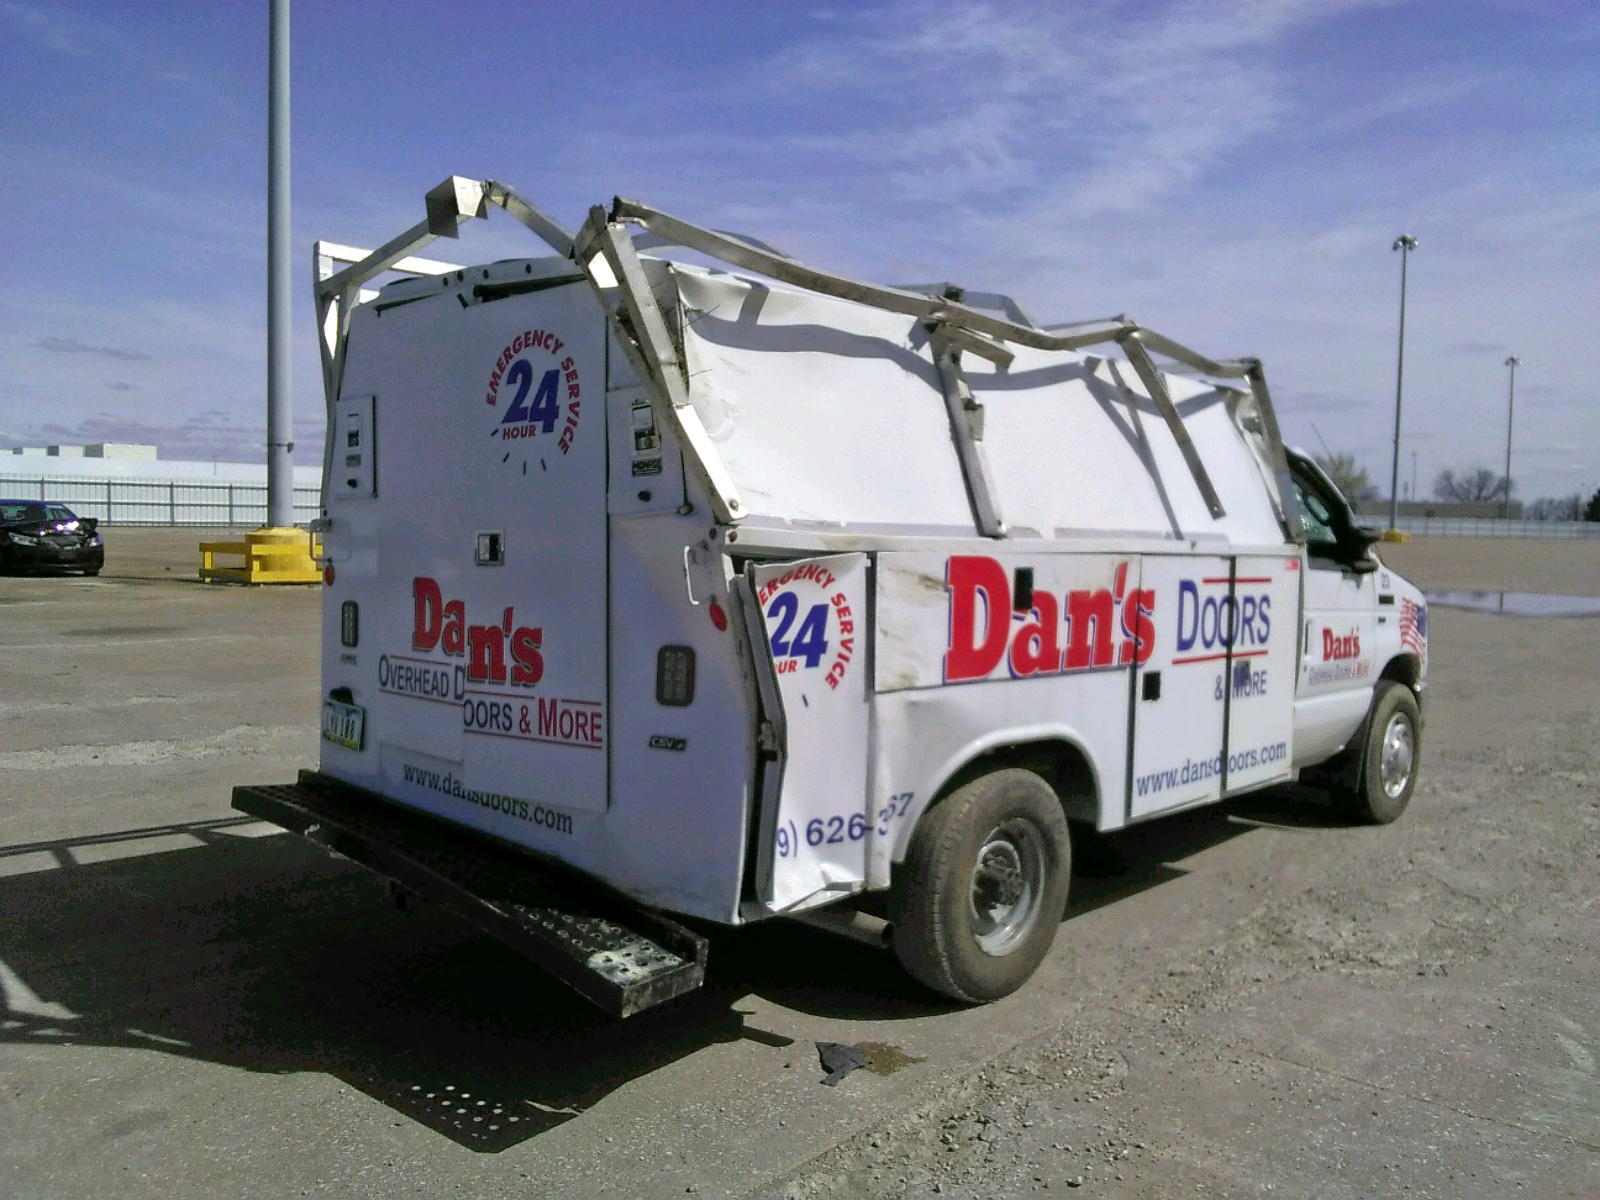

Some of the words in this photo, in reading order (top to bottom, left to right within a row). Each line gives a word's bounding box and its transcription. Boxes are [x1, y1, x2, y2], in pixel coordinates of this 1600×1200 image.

[486, 329, 564, 406] EMERGENCY
[557, 356, 581, 455] SERVICE
[501, 358, 561, 433] 24
[502, 424, 536, 440] HOUR
[412, 576, 544, 688] Dan's
[767, 591, 829, 669] 24
[825, 592, 854, 690] SERVICE
[943, 555, 1156, 685] Dan's
[1177, 579, 1272, 651] DOORS
[1322, 626, 1360, 661] Dan's
[379, 654, 449, 698] OVERHEAD
[454, 664, 513, 732] DOORS
[519, 704, 532, 734] &
[538, 697, 603, 742] MORE
[775, 659, 798, 674] UR
[1214, 674, 1223, 701] &
[1136, 742, 1287, 796] www.dansdoors.com
